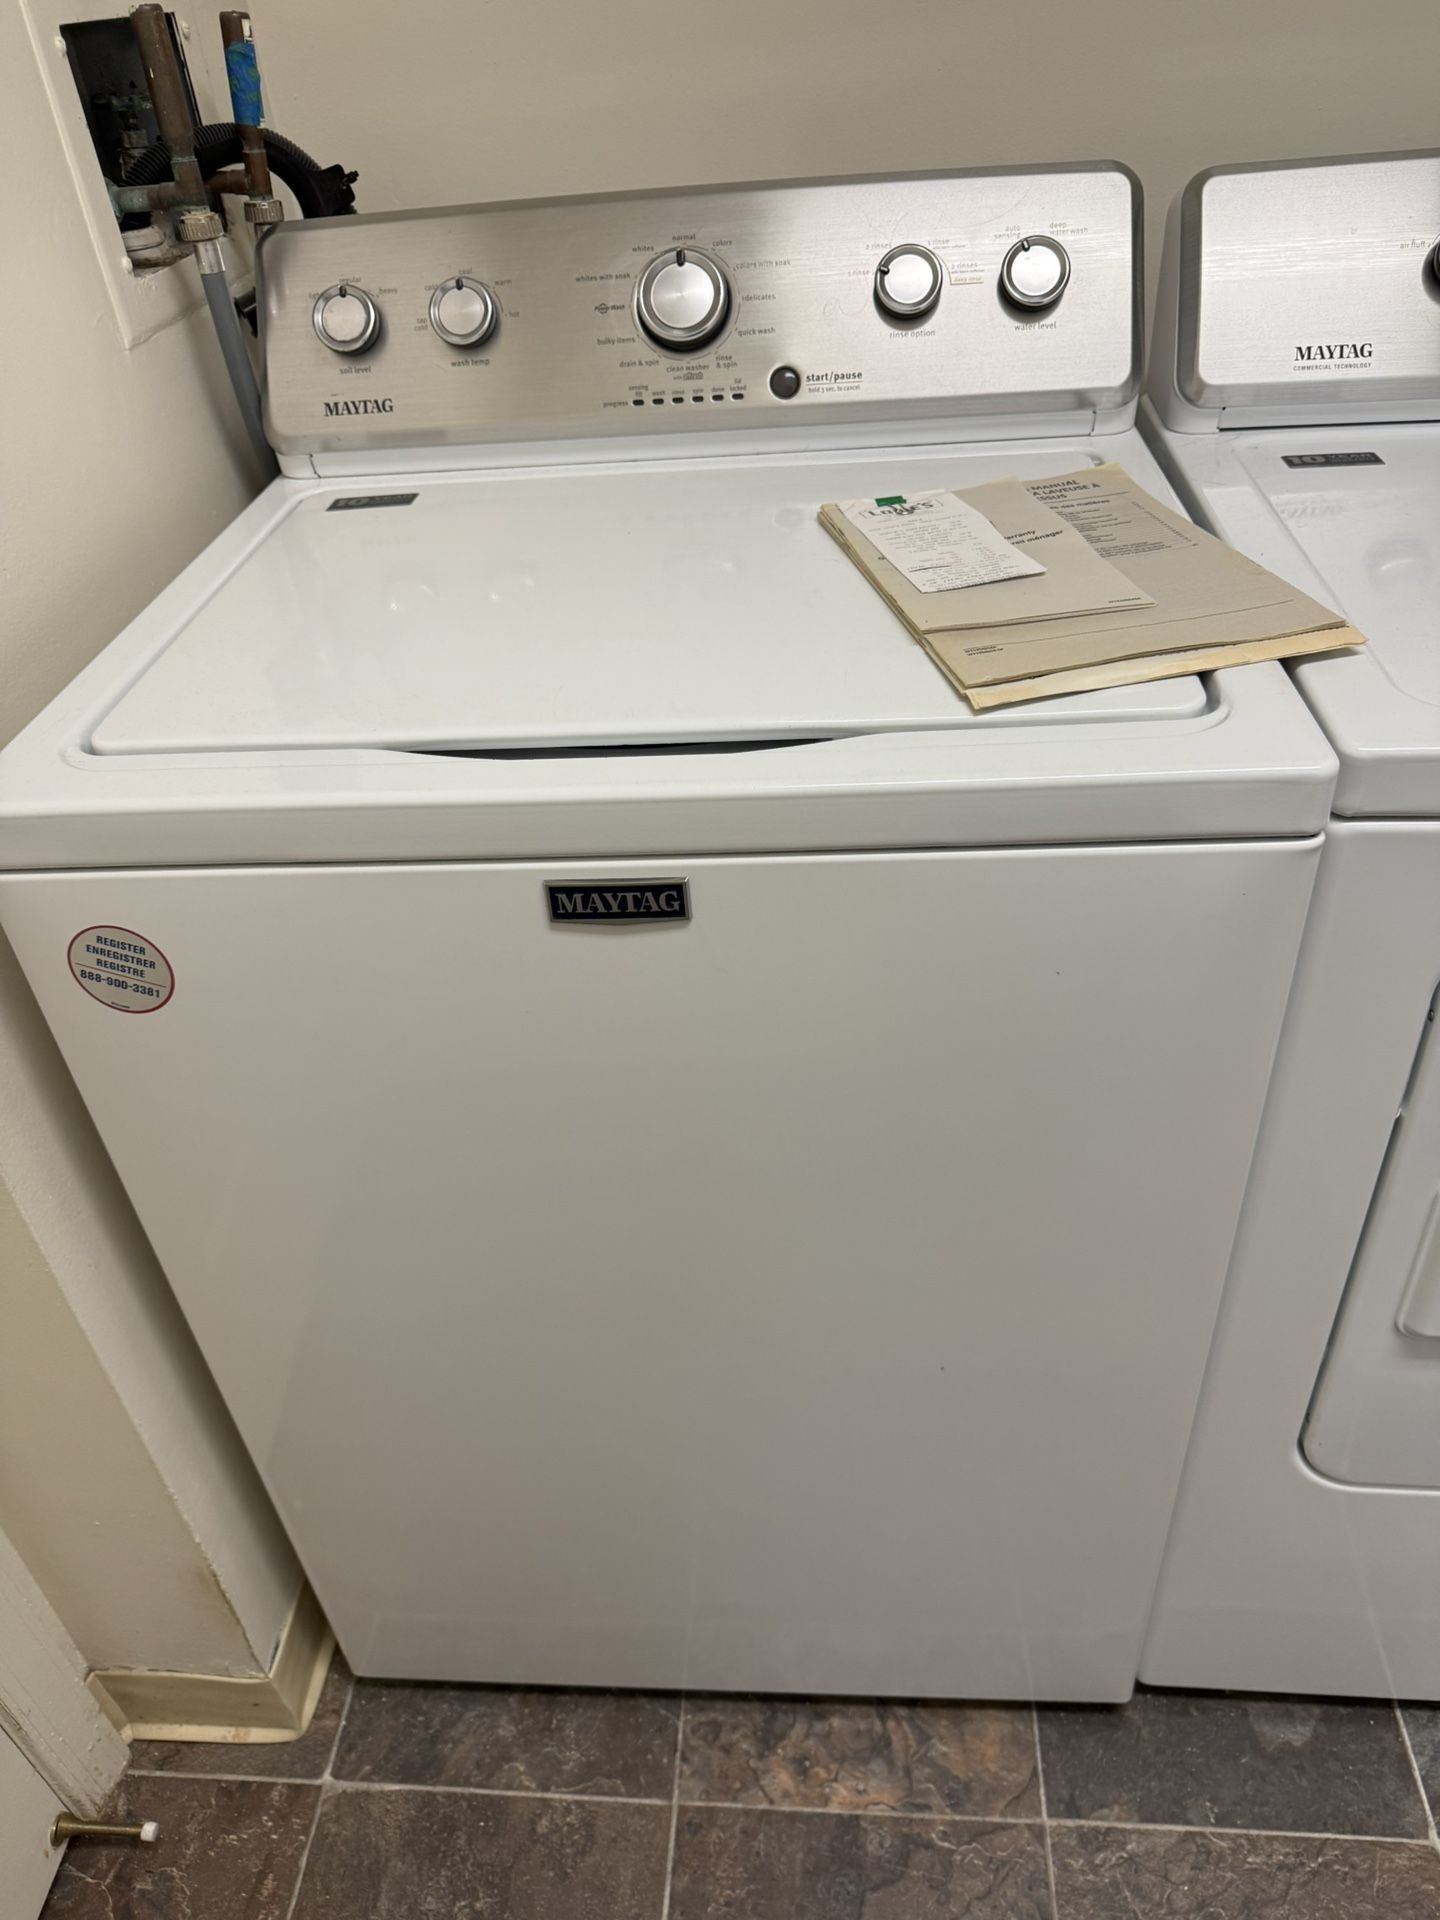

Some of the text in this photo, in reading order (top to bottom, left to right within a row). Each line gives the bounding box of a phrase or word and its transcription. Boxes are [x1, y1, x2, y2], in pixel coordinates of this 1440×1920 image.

[1049, 222, 1067, 230] deep
[672, 233, 696, 241] normal
[632, 244, 655, 253] whites
[712, 239, 733, 247] colors
[736, 259, 791, 270] colors with soak
[575, 271, 631, 282] whites with soak
[744, 292, 776, 302] delicates
[737, 326, 775, 338] quick wash
[1014, 321, 1057, 332] water level
[889, 328, 936, 340] rinse option
[597, 335, 636, 346] bulky items
[1294, 343, 1373, 361] MAYTAG
[451, 357, 491, 368] wash temp
[619, 359, 637, 368] drain
[644, 358, 660, 368] spin
[716, 354, 733, 362] rinse
[339, 365, 371, 375] soil level
[666, 362, 710, 373] clean washer
[722, 360, 738, 370] spin
[1293, 362, 1373, 372] COMMERCIAL TECHNOLOGY
[806, 370, 863, 383] start/pause
[808, 385, 820, 393] hold
[843, 383, 861, 392] cancel
[324, 398, 394, 417] MAYTAG
[602, 400, 629, 408] progress
[1288, 455, 1326, 465] 10
[1031, 479, 1080, 491] MANUAL
[1042, 484, 1090, 495] LAVEUSE
[1004, 530, 1036, 540] arranty
[554, 891, 681, 914] MAYTAG
[96, 935, 146, 956] REGISTER
[86, 944, 156, 969] ENREGISTRER
[96, 958, 146, 978] REGISTRE
[80, 969, 160, 998] 888-900-3381
